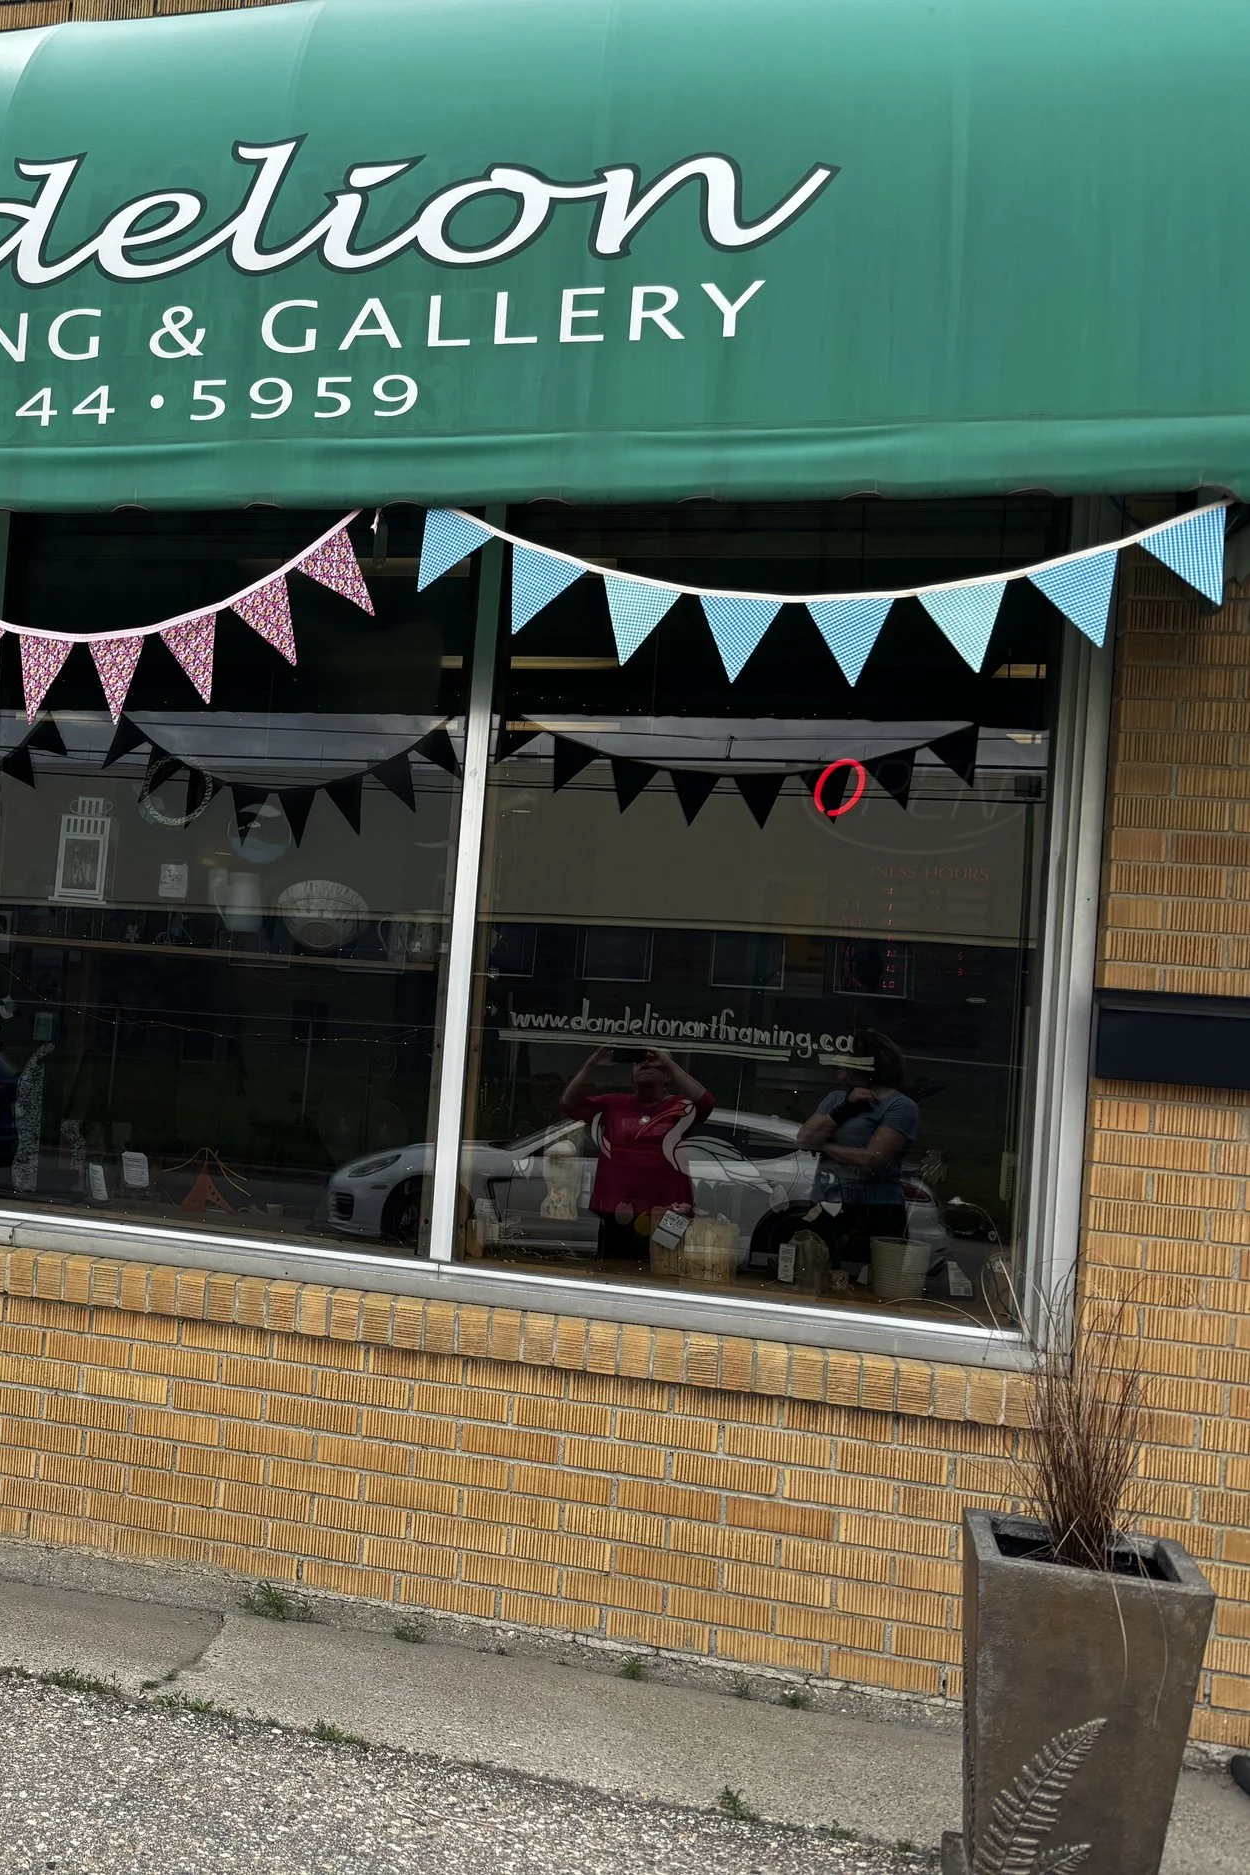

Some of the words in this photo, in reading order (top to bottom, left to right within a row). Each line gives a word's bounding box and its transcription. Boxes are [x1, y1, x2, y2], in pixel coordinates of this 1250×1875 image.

[148, 304, 207, 359] &
[259, 279, 768, 355] GALLERY
[924, 866, 990, 882] HOURS
[509, 998, 855, 1059] www.dandelionartframing.ca
